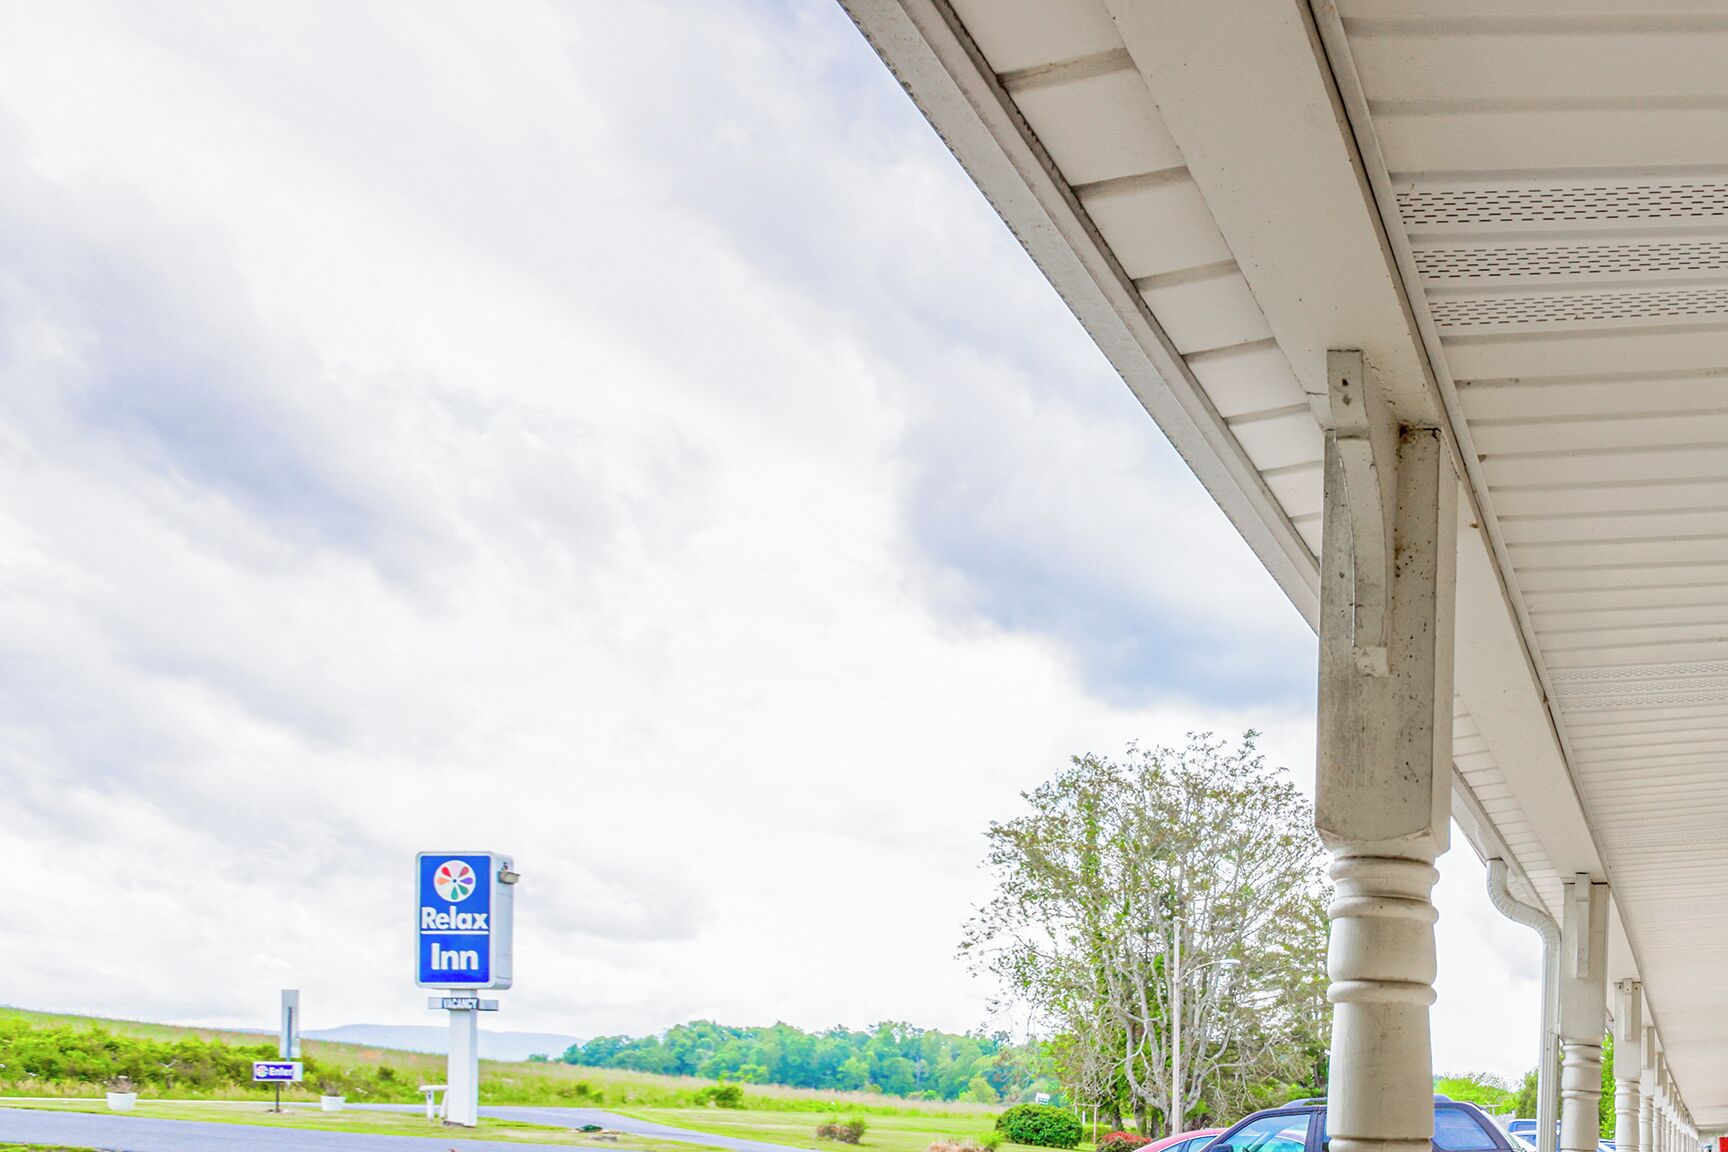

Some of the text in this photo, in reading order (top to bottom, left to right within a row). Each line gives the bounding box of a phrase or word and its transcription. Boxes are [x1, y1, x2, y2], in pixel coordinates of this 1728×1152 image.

[421, 905, 489, 929] Relax
[431, 942, 479, 970] Inn
[443, 998, 478, 1009] VACANCY
[269, 1066, 293, 1076] Enter
